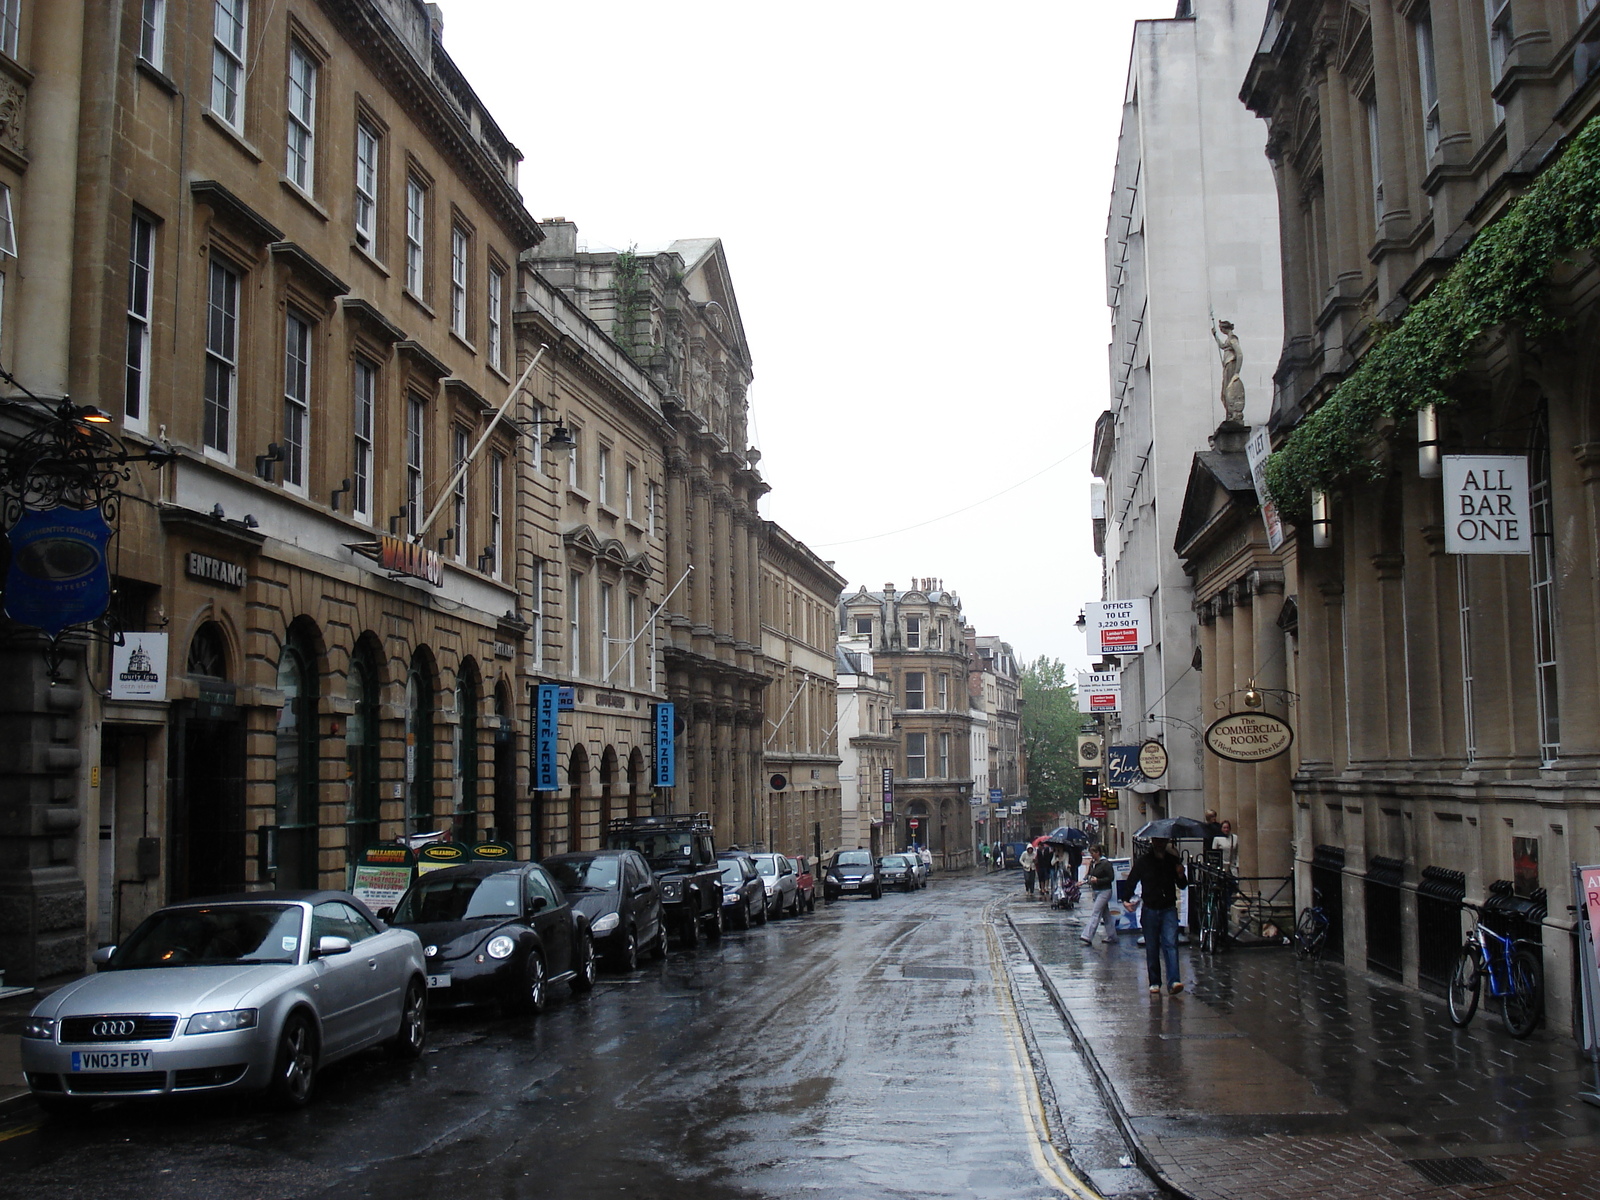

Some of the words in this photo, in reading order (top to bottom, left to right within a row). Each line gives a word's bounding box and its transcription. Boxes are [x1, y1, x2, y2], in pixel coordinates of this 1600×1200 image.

[1255, 433, 1264, 455] LET
[1461, 469, 1512, 491] ALL
[1459, 494, 1516, 516] BAR
[66, 525, 98, 541] ITALIAN
[1457, 519, 1519, 541] ONE
[190, 552, 247, 588] ENTRANCE
[1103, 602, 1134, 610] OFFICES
[1098, 620, 1118, 629] 3,220
[1101, 674, 1115, 682] LET
[542, 689, 554, 738] CAFFÉ
[660, 707, 671, 746] CAFFÉ
[1215, 723, 1283, 736] COMMERCIAL
[1217, 741, 1259, 757] Wetherspoon
[1259, 747, 1272, 756] Free
[1272, 735, 1287, 750] House
[1230, 734, 1269, 745] ROOMS
[541, 740, 551, 785] NERO
[660, 748, 669, 782] NERO
